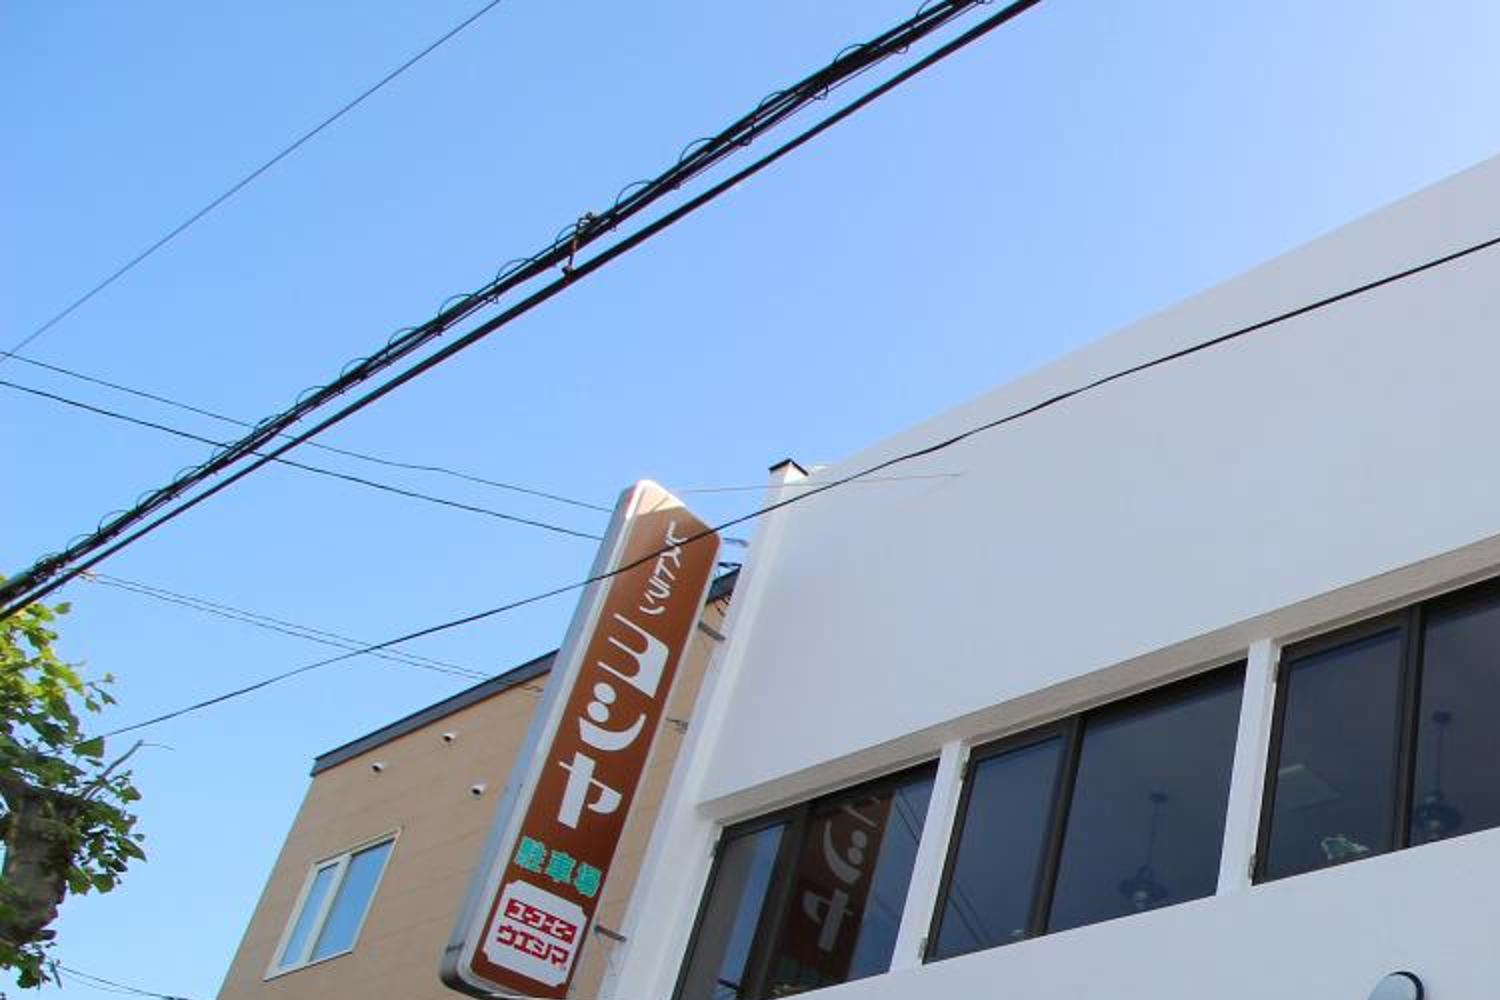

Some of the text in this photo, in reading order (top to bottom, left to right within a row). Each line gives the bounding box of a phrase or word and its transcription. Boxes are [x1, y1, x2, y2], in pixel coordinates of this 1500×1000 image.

[639, 521, 689, 615] レストラン
[558, 613, 670, 829] ヨシヤ
[497, 925, 569, 966] ウエシマ
